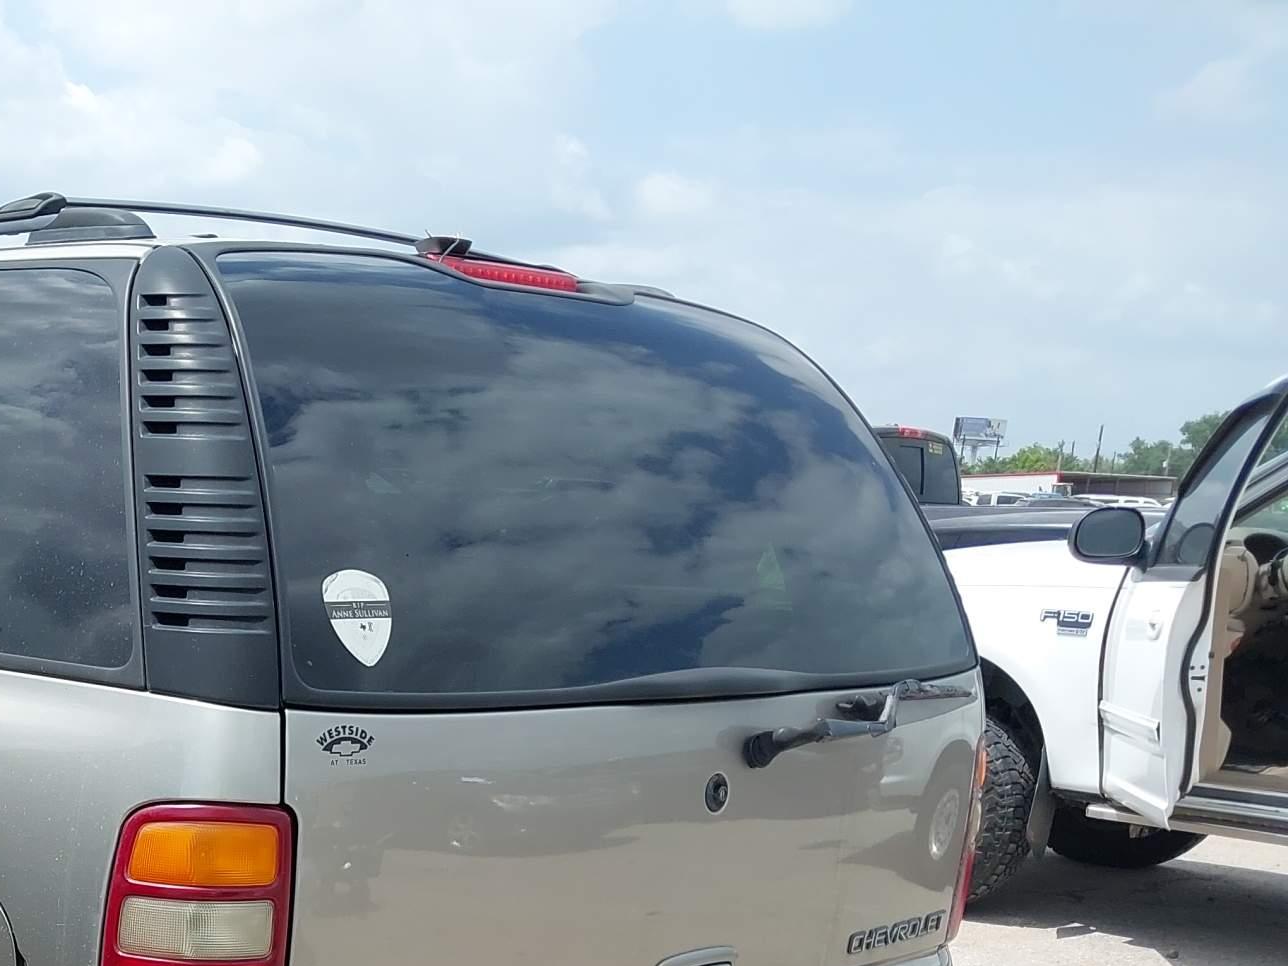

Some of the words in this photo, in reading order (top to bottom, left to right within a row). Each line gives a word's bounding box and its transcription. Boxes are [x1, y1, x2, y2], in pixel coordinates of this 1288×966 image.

[332, 609, 353, 618] ANNE
[354, 608, 389, 618] SULLIVAN
[316, 725, 375, 746] WESTSIDE
[346, 758, 366, 766] TEXAS
[847, 909, 946, 954] CHEVROLET
